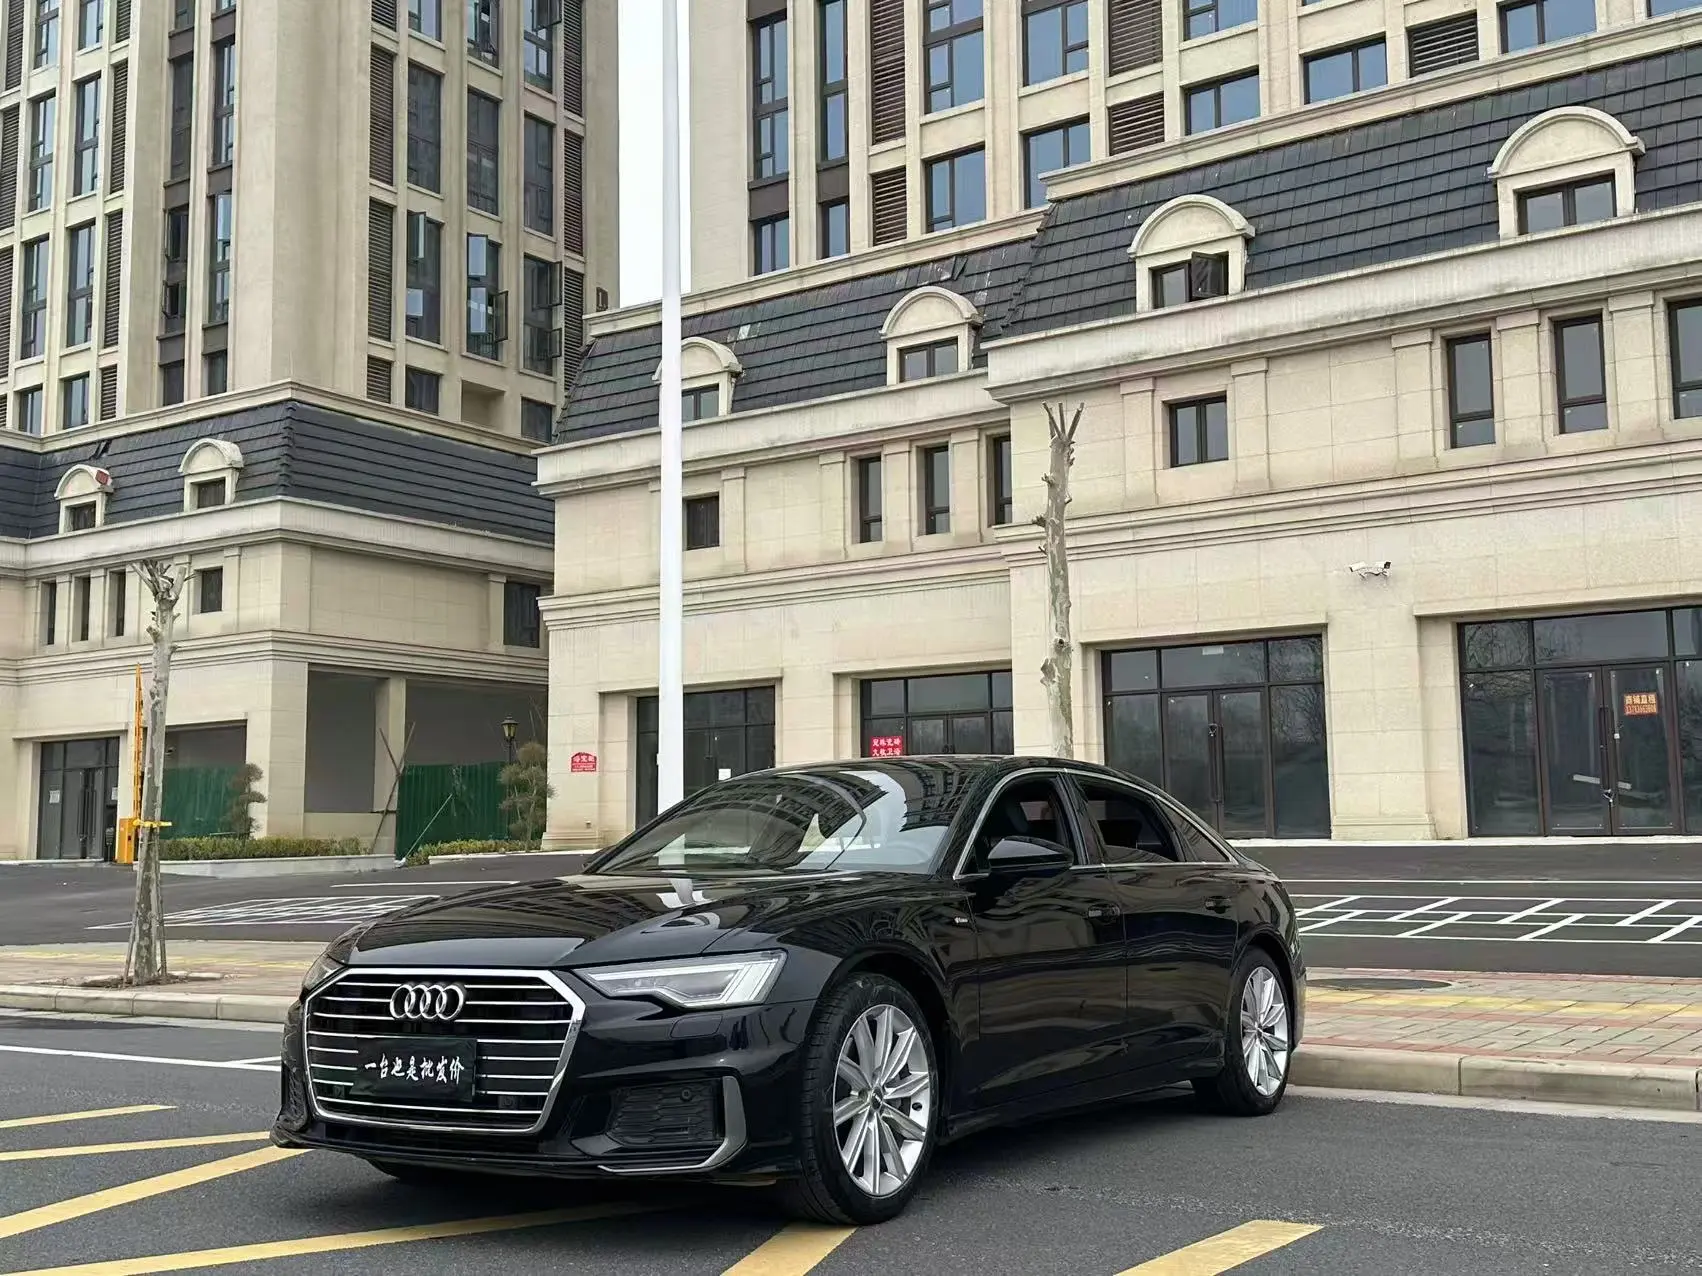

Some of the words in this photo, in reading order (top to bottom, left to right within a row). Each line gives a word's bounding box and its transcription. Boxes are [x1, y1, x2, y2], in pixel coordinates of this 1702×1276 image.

[364, 1052, 465, 1085] 一台也是批发价
